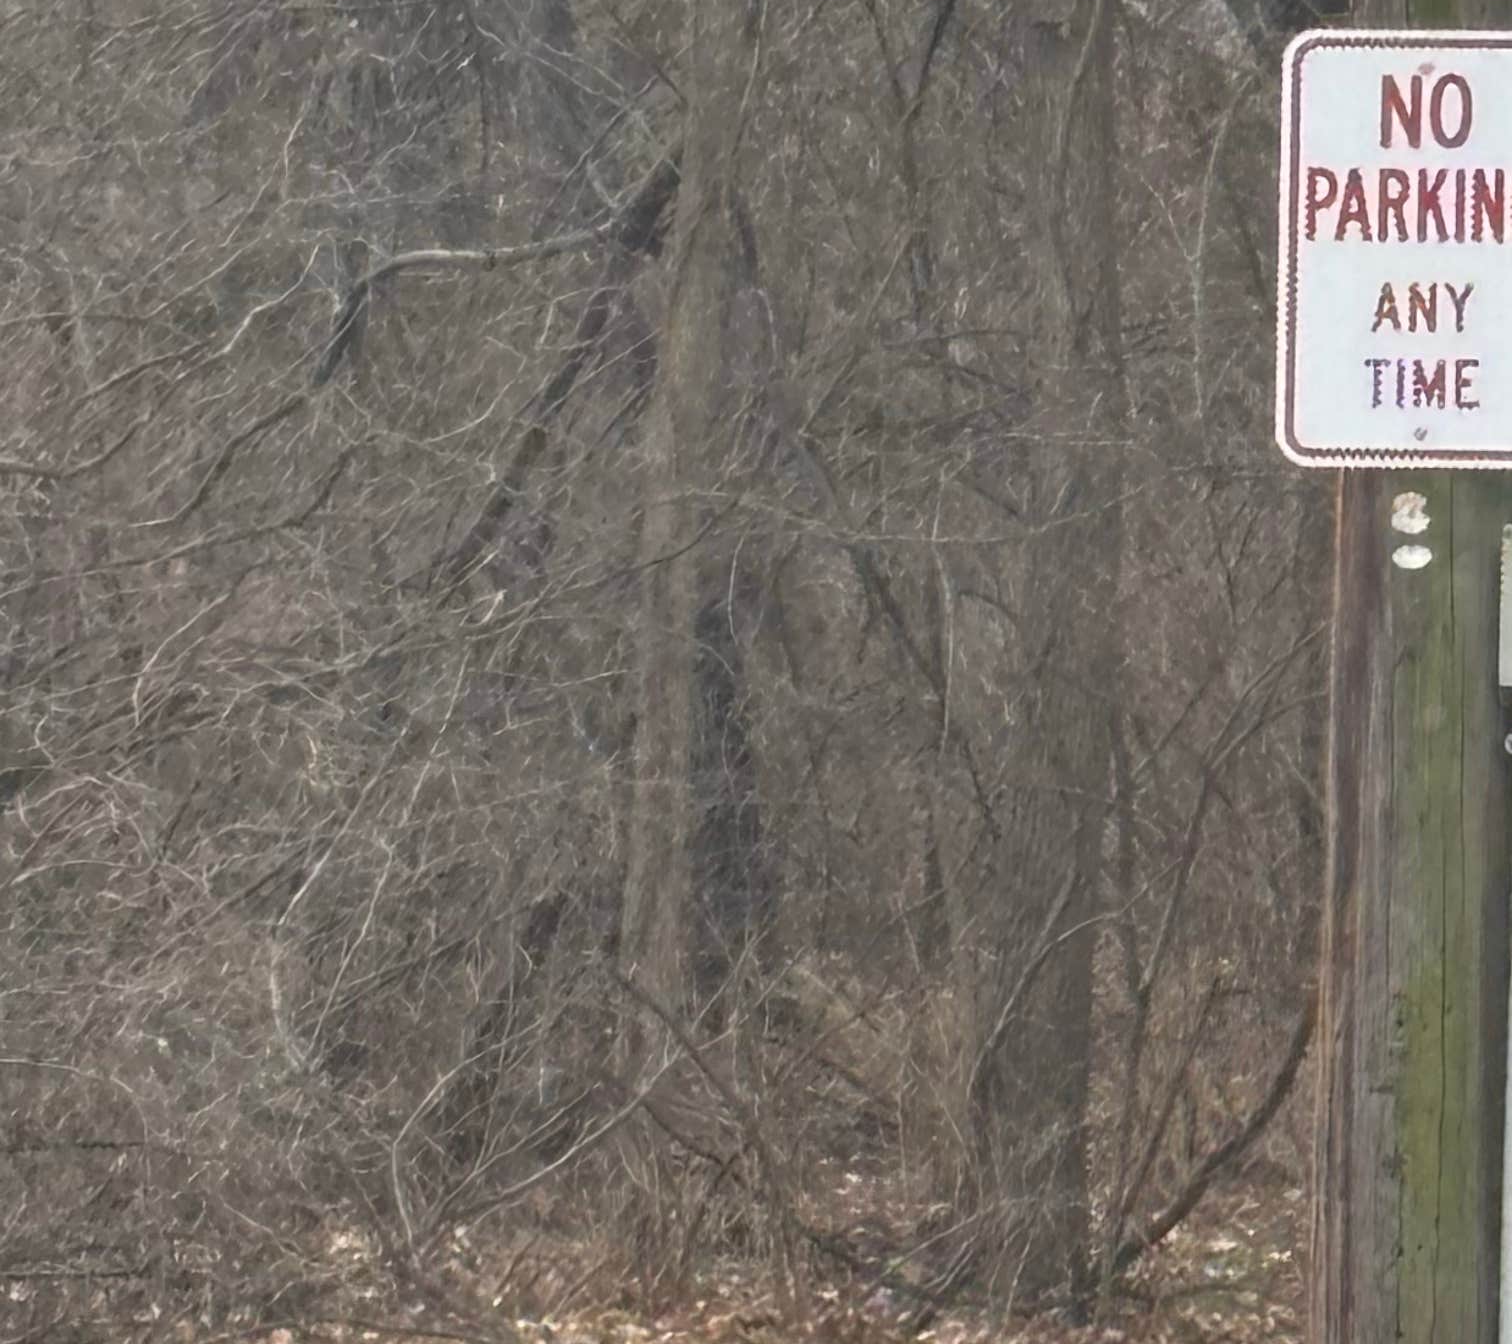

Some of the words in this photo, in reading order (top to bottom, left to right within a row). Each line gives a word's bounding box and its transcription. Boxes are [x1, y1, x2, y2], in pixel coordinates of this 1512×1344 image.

[1379, 73, 1473, 149] NO
[1371, 281, 1474, 333] ANY
[1364, 358, 1480, 410] TIME
